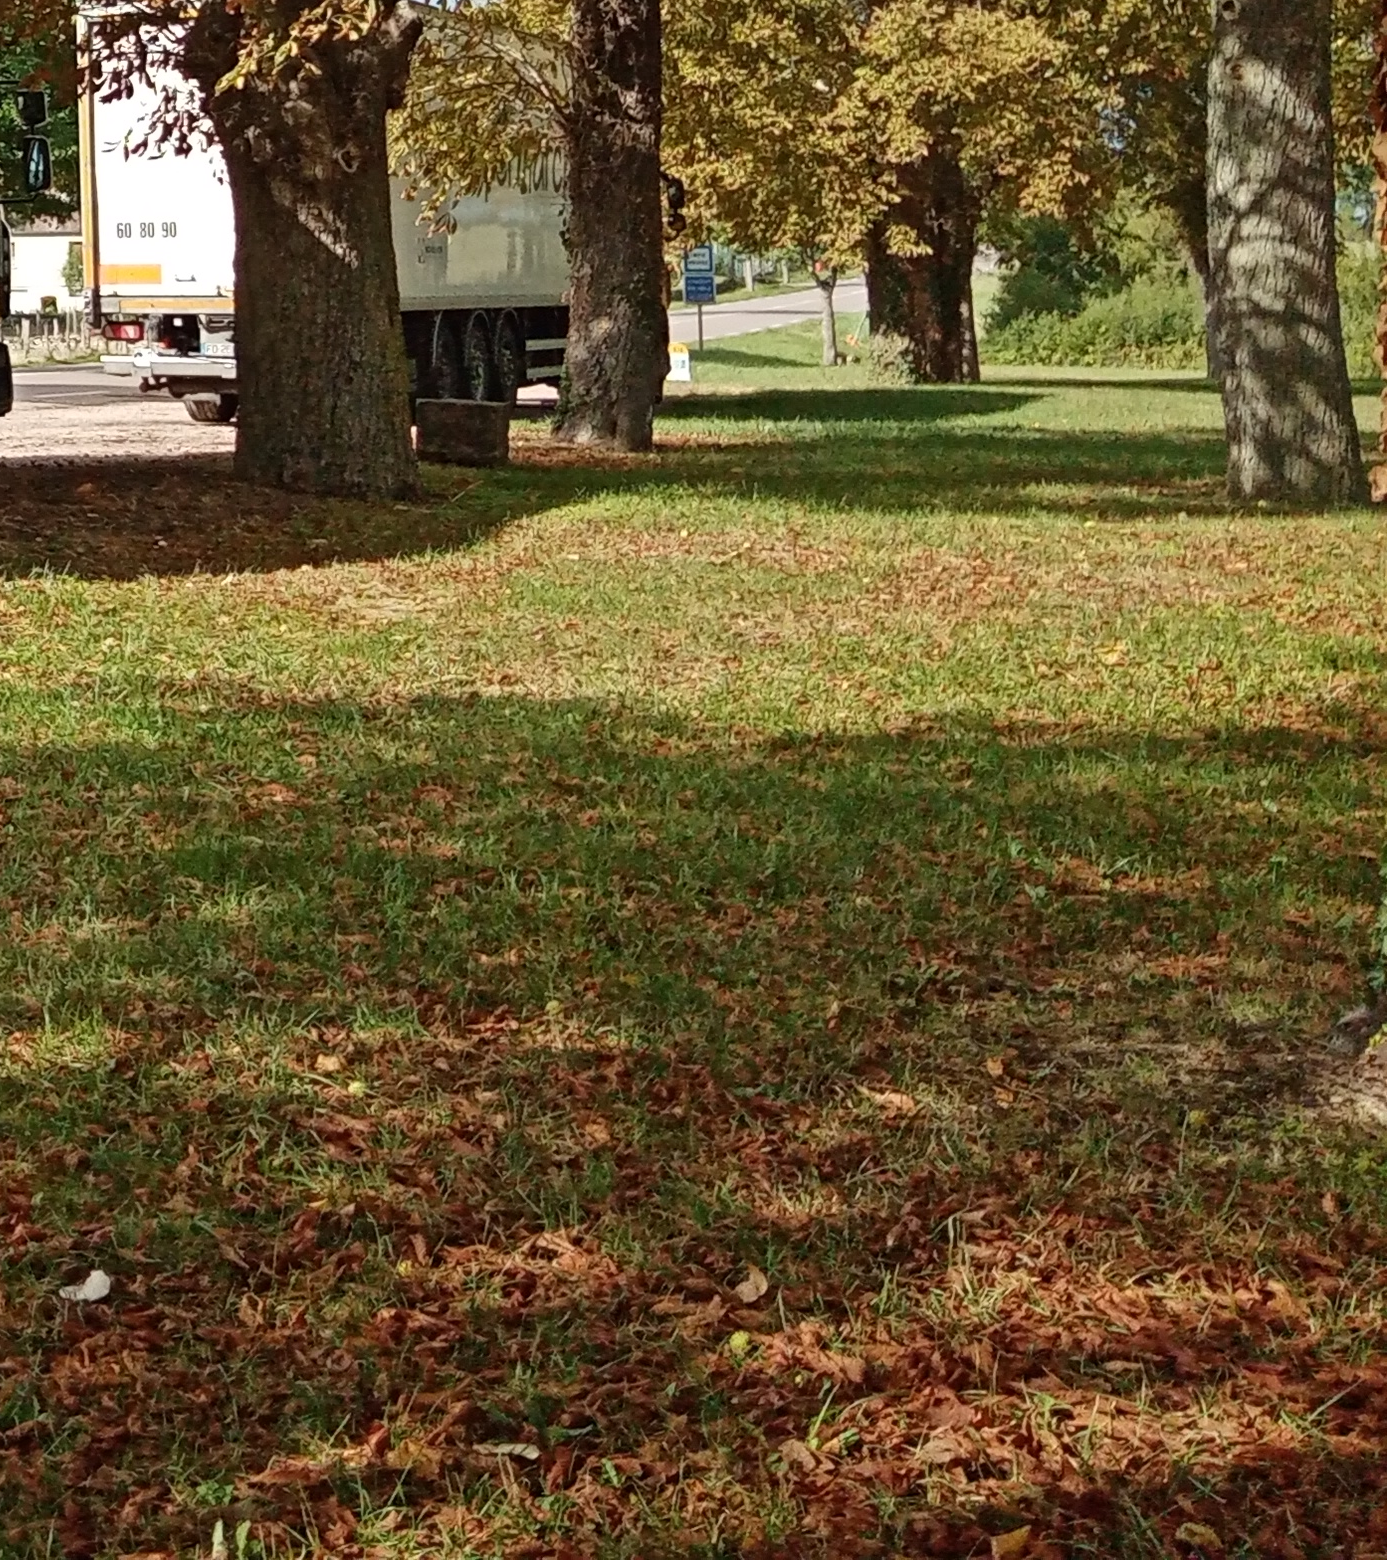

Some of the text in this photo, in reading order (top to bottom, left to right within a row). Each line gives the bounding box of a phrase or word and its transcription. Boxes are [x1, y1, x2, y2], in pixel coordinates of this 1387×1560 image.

[116, 221, 178, 239] 60 80 90
